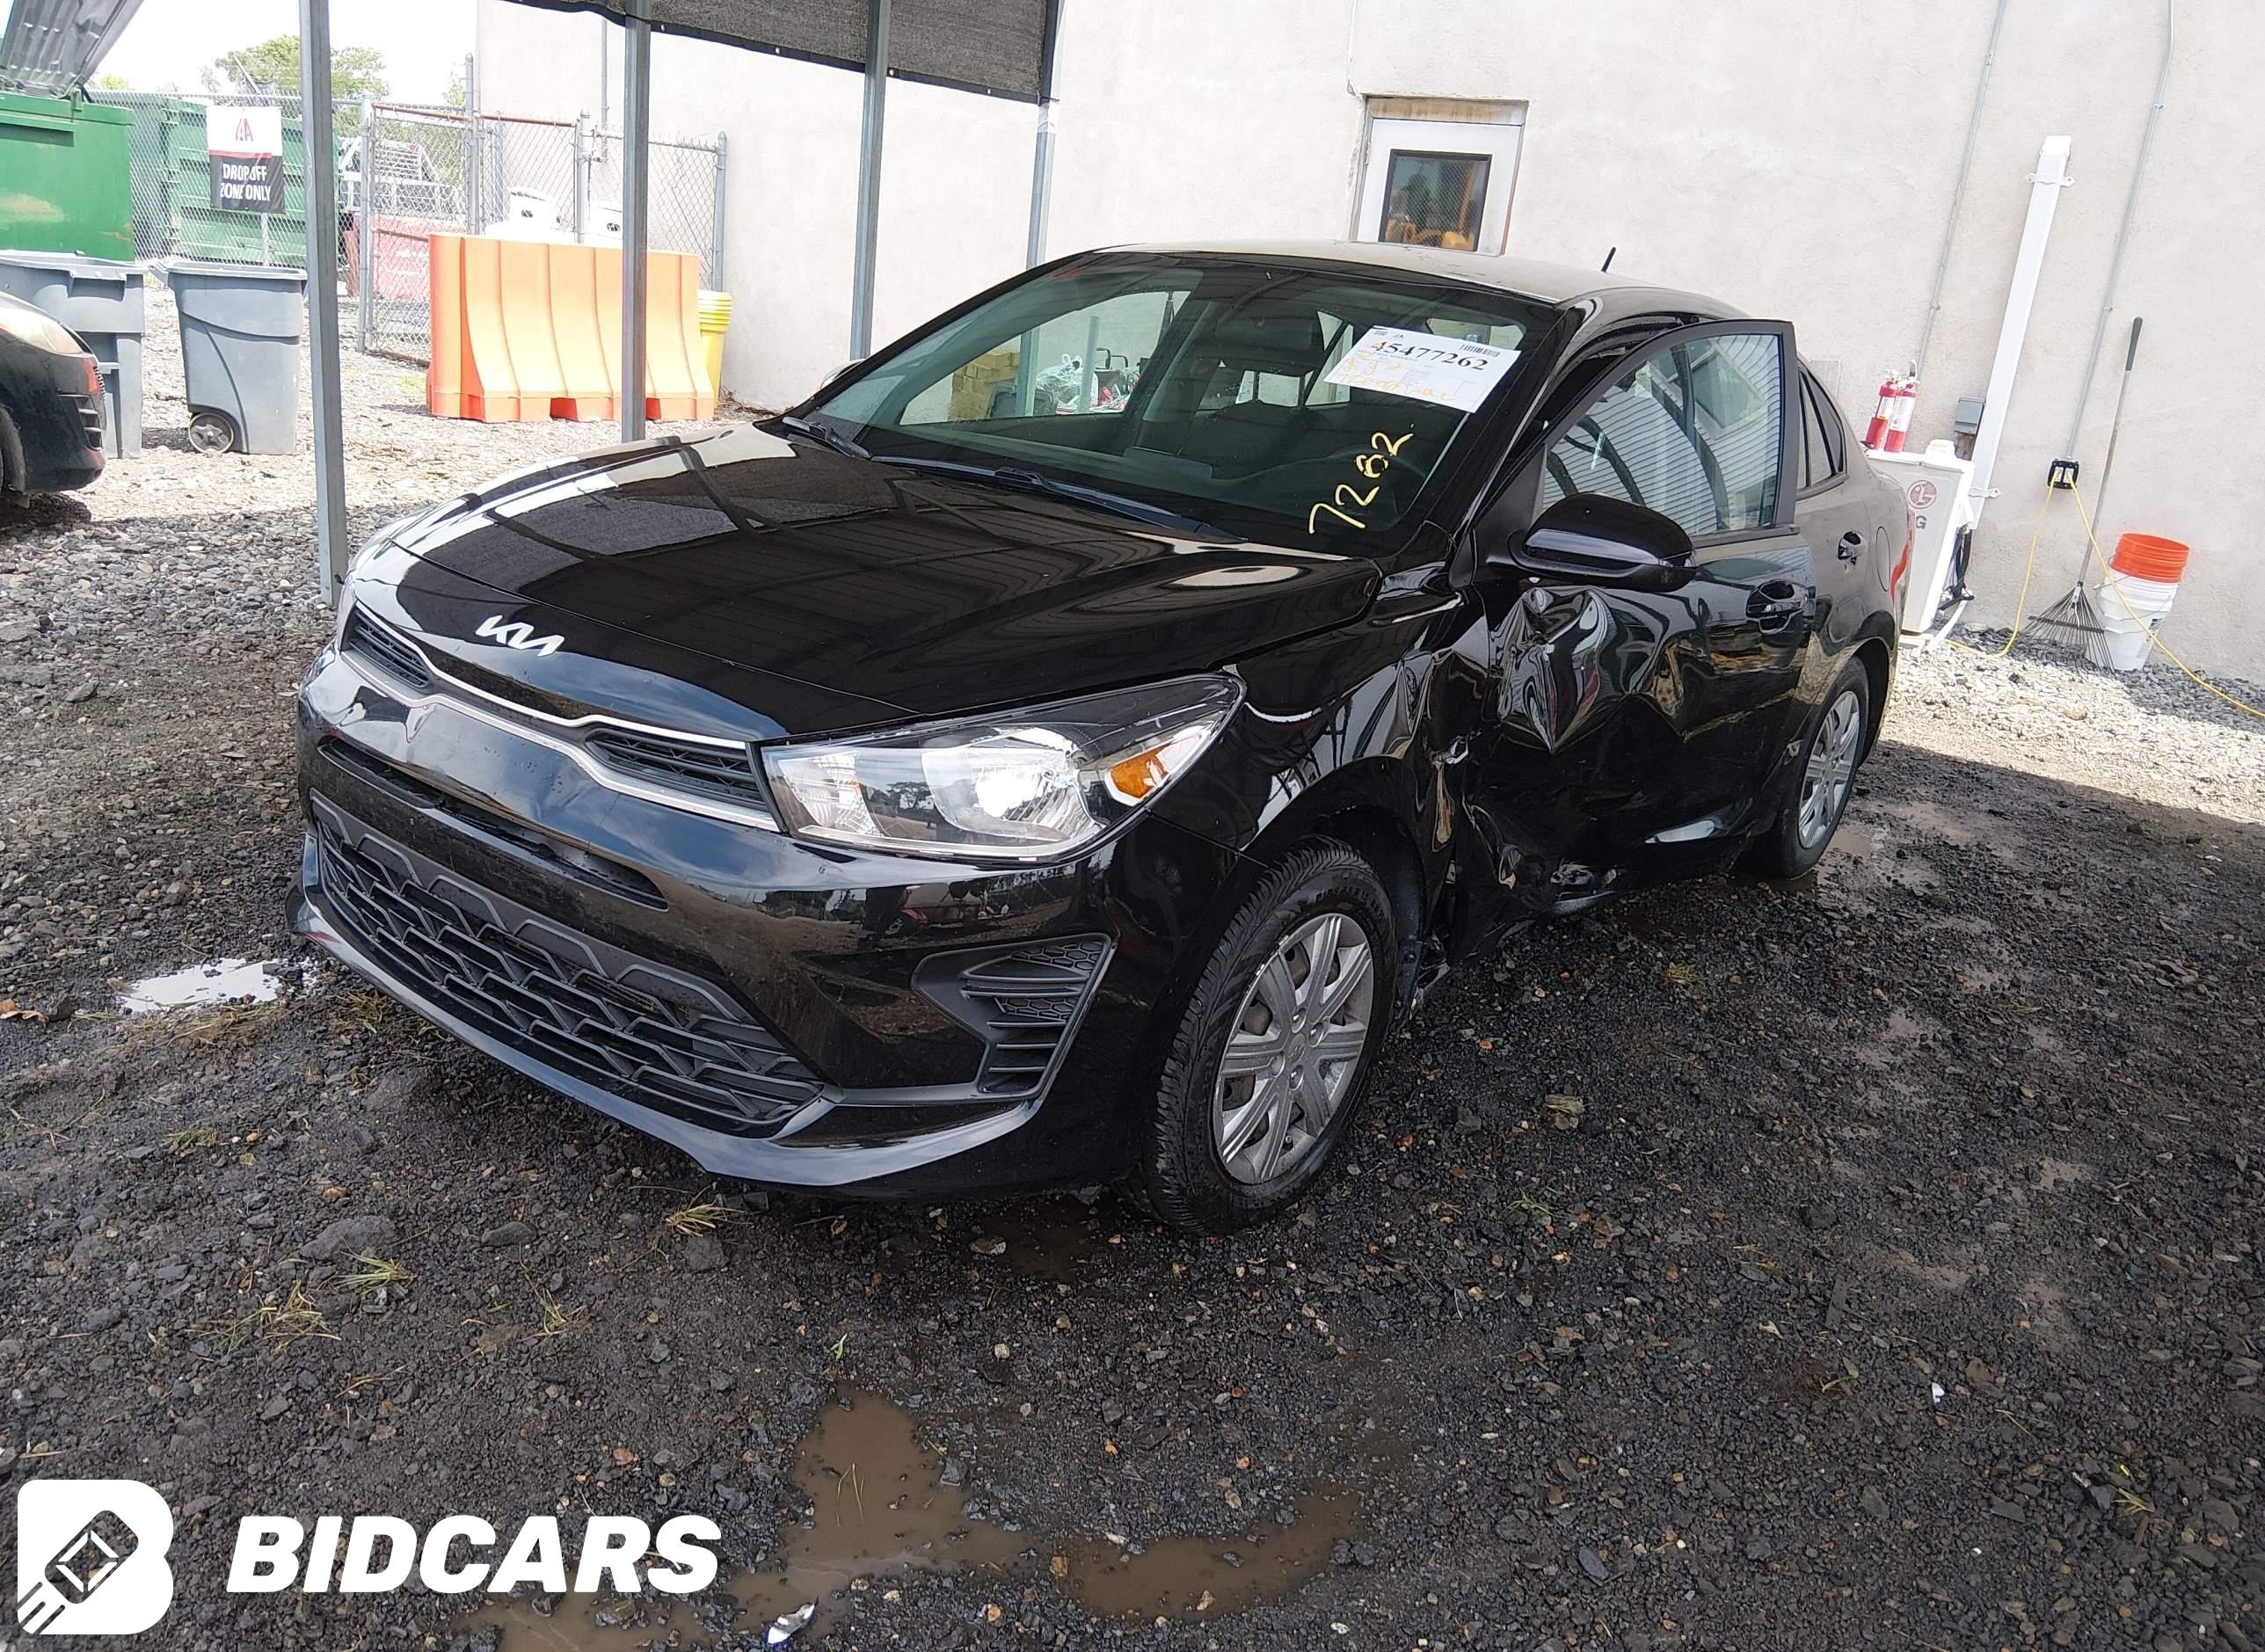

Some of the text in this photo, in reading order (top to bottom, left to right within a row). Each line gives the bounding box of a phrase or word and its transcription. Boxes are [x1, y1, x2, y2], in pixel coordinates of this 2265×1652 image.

[222, 163, 249, 181] DROP
[245, 185, 272, 201] ONLY
[1372, 340, 1489, 371] 45477262
